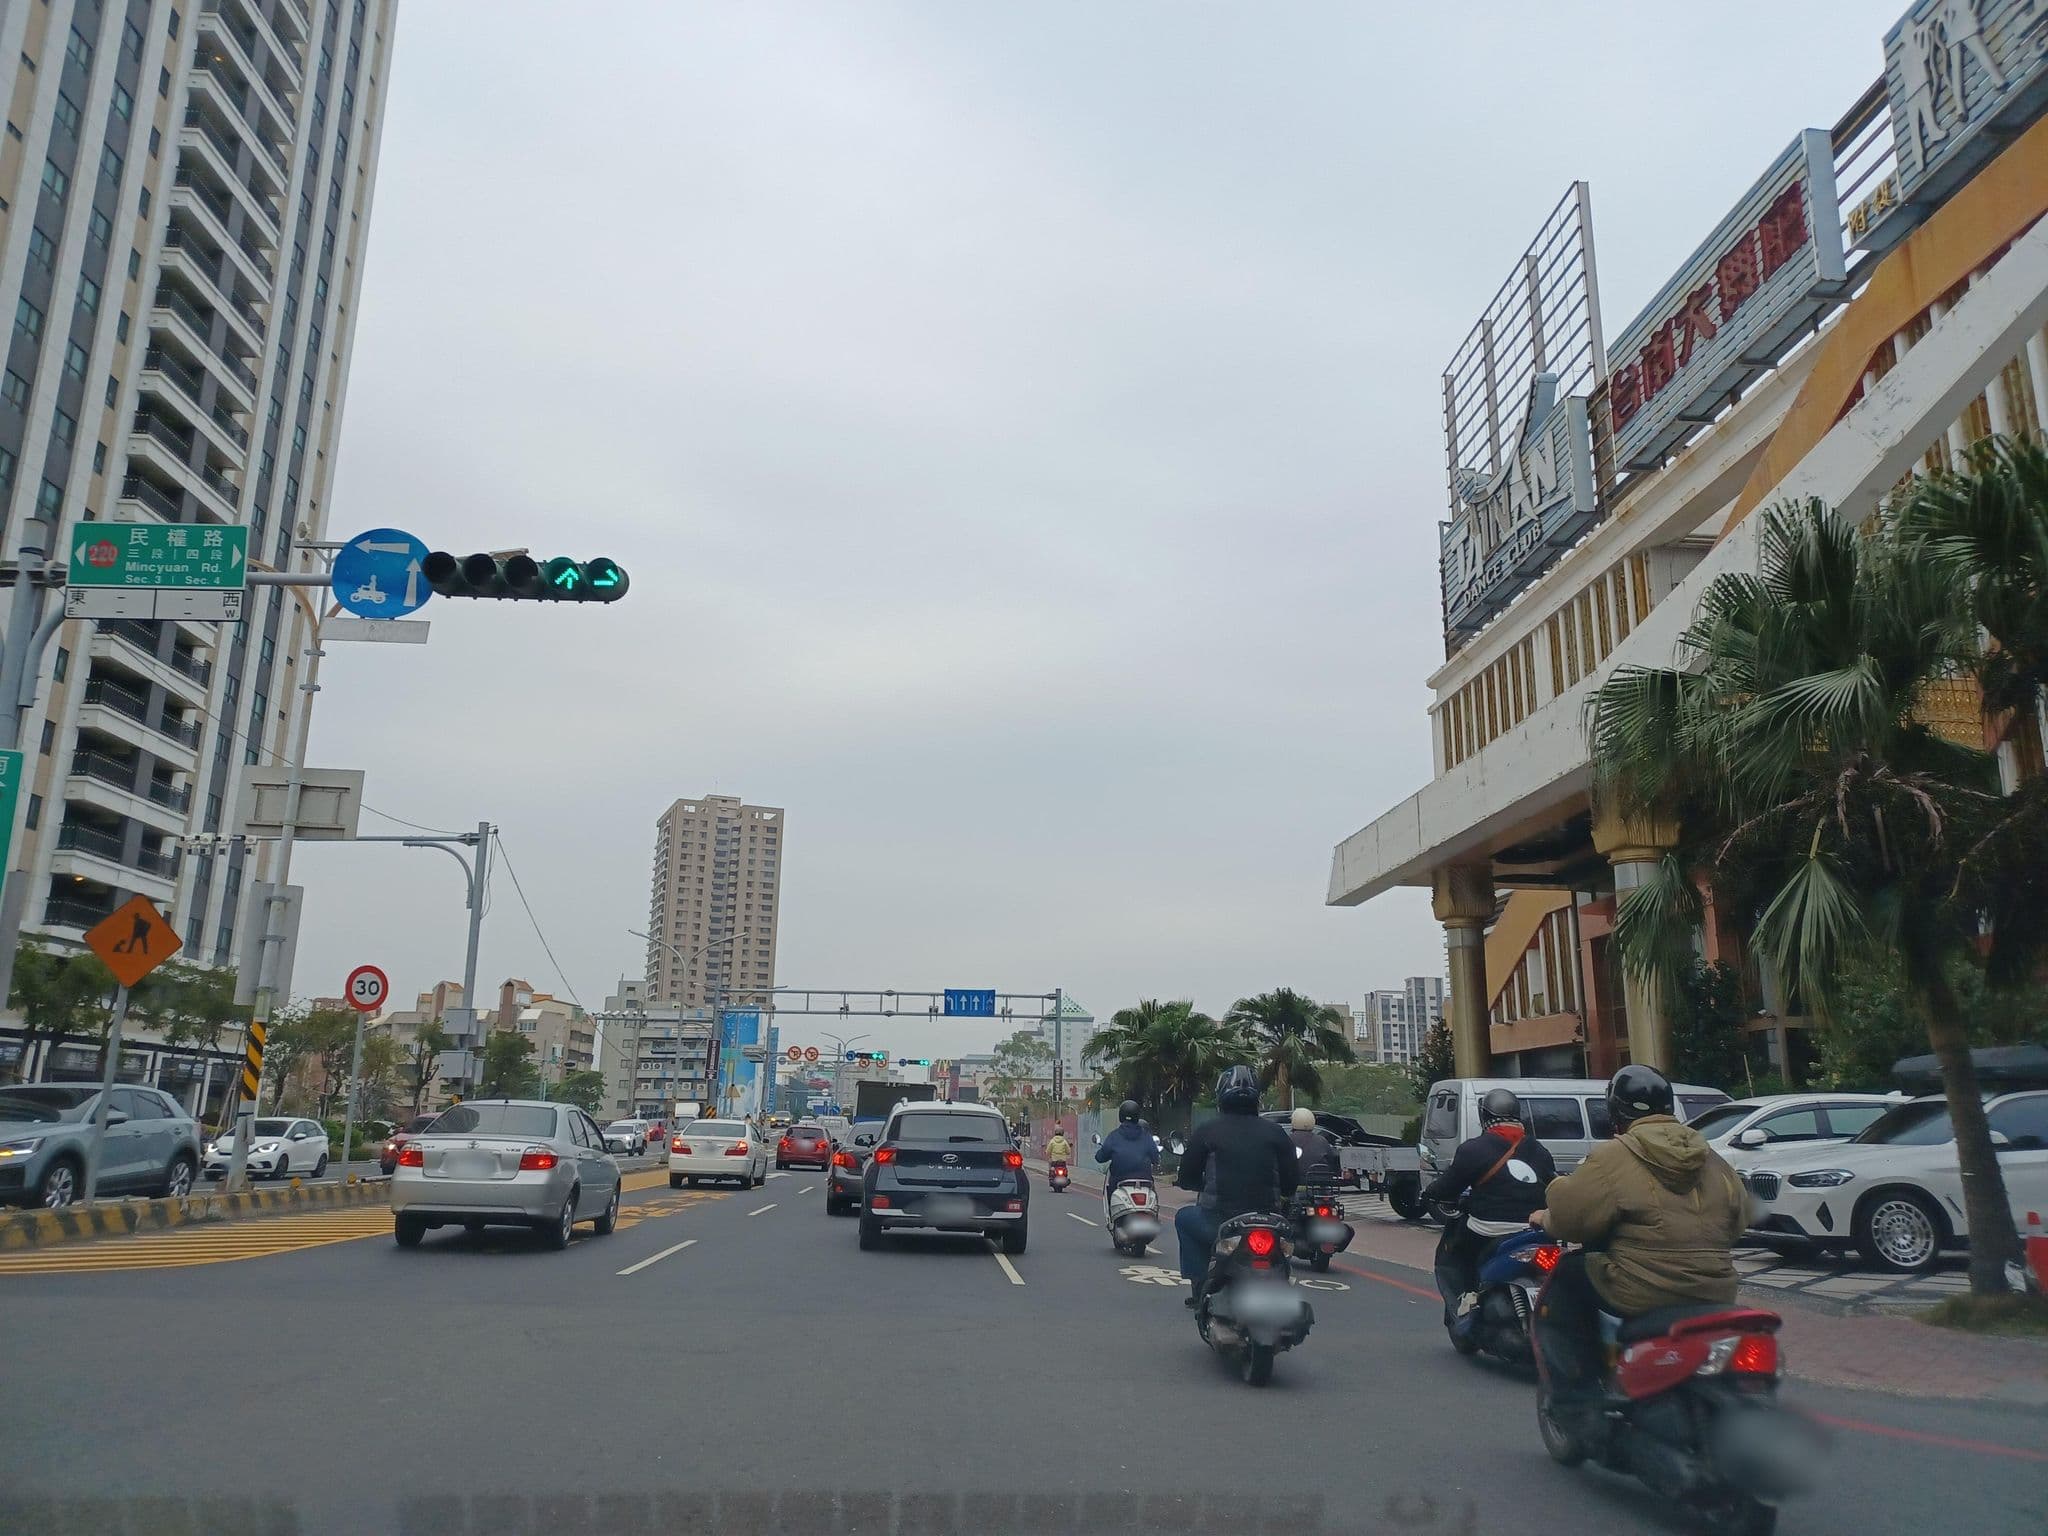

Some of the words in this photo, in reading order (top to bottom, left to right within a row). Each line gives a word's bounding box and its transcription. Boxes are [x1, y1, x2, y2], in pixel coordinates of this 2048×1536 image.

[127, 527, 223, 547] 民權路
[125, 561, 189, 574] Mincyuan
[201, 562, 222, 573] Rd.
[1463, 562, 1501, 608] DANCE
[1508, 524, 1542, 565] CLUB
[125, 574, 150, 584] Sec.
[154, 575, 161, 584] 3
[185, 575, 209, 585] Sec.
[212, 576, 221, 585] 4
[69, 590, 87, 605] 東
[222, 592, 240, 607] 西
[355, 980, 380, 995] 30
